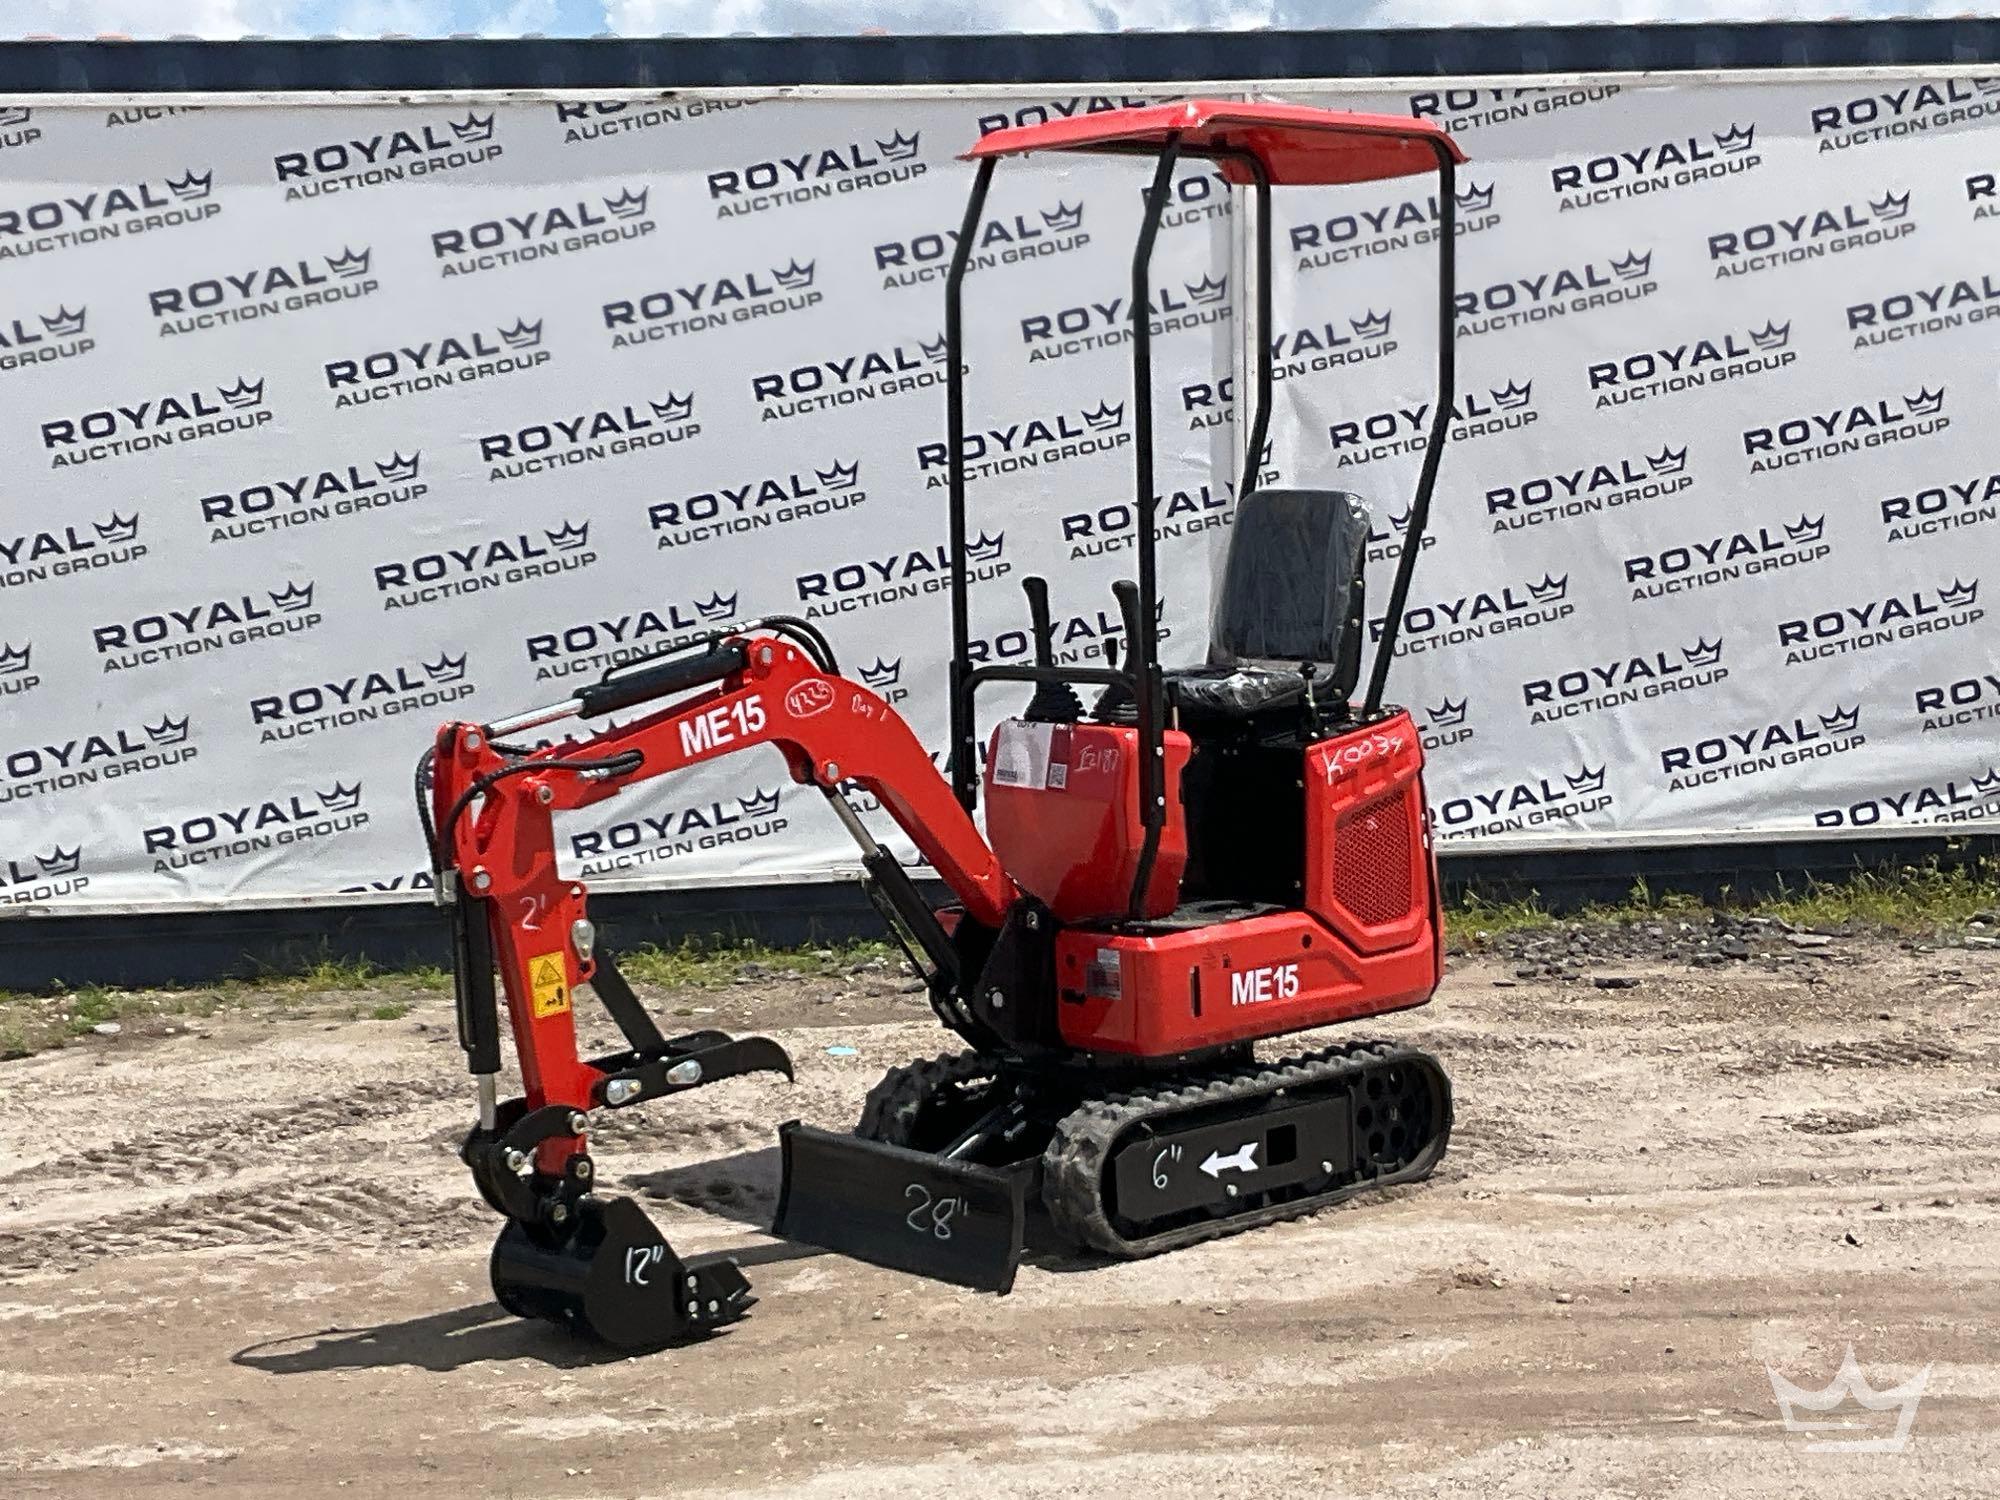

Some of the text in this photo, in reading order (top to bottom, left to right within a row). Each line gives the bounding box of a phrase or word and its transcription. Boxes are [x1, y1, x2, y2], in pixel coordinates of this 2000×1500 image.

[564, 109, 680, 144] AUCTION
[1535, 86, 1622, 114] GROUP
[1812, 79, 1973, 134] ROYAL
[274, 127, 450, 180] ROYAL
[1818, 117, 1927, 153] AUCTION
[286, 145, 502, 200] AUCTION GROUP
[707, 145, 876, 198] ROYAL
[719, 163, 926, 218] AUCTION GROUP
[1551, 138, 1713, 192] ROYAL
[1560, 155, 1760, 212] AUCTION GROUP
[0, 203, 219, 258] AUCTION GROUP
[431, 203, 604, 257] ROYAL
[443, 221, 655, 277] AUCTION GROUP
[1003, 234, 1090, 264] GROUP
[1298, 237, 1408, 271] AUCTION
[1708, 205, 1868, 260] ROYAL
[1717, 223, 1915, 279] AUCTION GROUP
[149, 262, 326, 316] ROYAL
[161, 280, 378, 336] AUCTION GROUP
[602, 274, 772, 328] ROYAL
[1454, 264, 1610, 318] ROYAL
[1457, 283, 1657, 338] AUCTION GROUP
[614, 292, 822, 348] AUCTION GROUP
[1854, 313, 1962, 350] AUCTION
[0, 339, 95, 370] GROUP
[325, 333, 499, 388] ROYAL
[337, 351, 550, 408] AUCTION GROUP
[752, 347, 920, 401] ROYAL
[1312, 342, 1399, 372] GROUP
[1588, 335, 1749, 389] ROYAL
[1597, 352, 1796, 409] AUCTION GROUP
[41, 393, 219, 447] ROYAL
[763, 387, 874, 421] AUCTION
[1743, 400, 1903, 455] ROYAL
[53, 411, 272, 467] AUCTION GROUP
[480, 407, 650, 461] ROYAL
[491, 425, 701, 481] AUCTION GROUP
[1044, 433, 1131, 463] GROUP
[1337, 411, 1540, 468] AUCTIO GROUP
[1752, 418, 1950, 474] AUCTION GROUP
[200, 467, 376, 522] ROYAL
[212, 484, 427, 542] AUCTION GROUP
[648, 475, 816, 529] ROYAL
[1485, 460, 1646, 514] ROYAL
[1494, 478, 1693, 534] AUCTION GROUP
[659, 493, 866, 549] AUCTION GROUP
[1887, 507, 1997, 543] AUCTION
[53, 545, 149, 577] GROUP
[374, 535, 546, 590] ROYAL
[386, 553, 596, 610] AUCTION GROUP
[1624, 528, 1783, 582] ROYAL
[1633, 546, 1830, 602] AUCTION GROUP
[94, 597, 269, 651] ROYAL
[807, 586, 917, 620] AUCTION
[1778, 592, 1937, 646] ROYAL
[106, 614, 321, 672] AUCTION GROUP
[526, 606, 695, 661] ROYAL
[1393, 606, 1574, 658] UCTION GROUP
[1787, 610, 1983, 666] AUCTION GROUP
[250, 668, 423, 723] ROYAL
[1522, 651, 1681, 706] ROYAL
[1531, 669, 1728, 726] AUCTION GROUP
[261, 685, 474, 743] AUCTION GROUP
[679, 694, 766, 757] ME15
[0, 730, 147, 781] OYAL
[105, 747, 199, 779] GROUP
[1660, 719, 1819, 773] ROYAL
[1669, 736, 1865, 792] AUCTION GROUP
[142, 797, 317, 852] ROYAL
[571, 804, 740, 858] ROYAL
[1529, 795, 1614, 826] GROUP
[154, 814, 369, 872] AUCTION GROUP
[580, 819, 788, 878] AUCTION GROUP
[1231, 964, 1299, 1006] ME15
[1152, 1144, 1182, 1189] 6"
[905, 1184, 968, 1239] 28"
